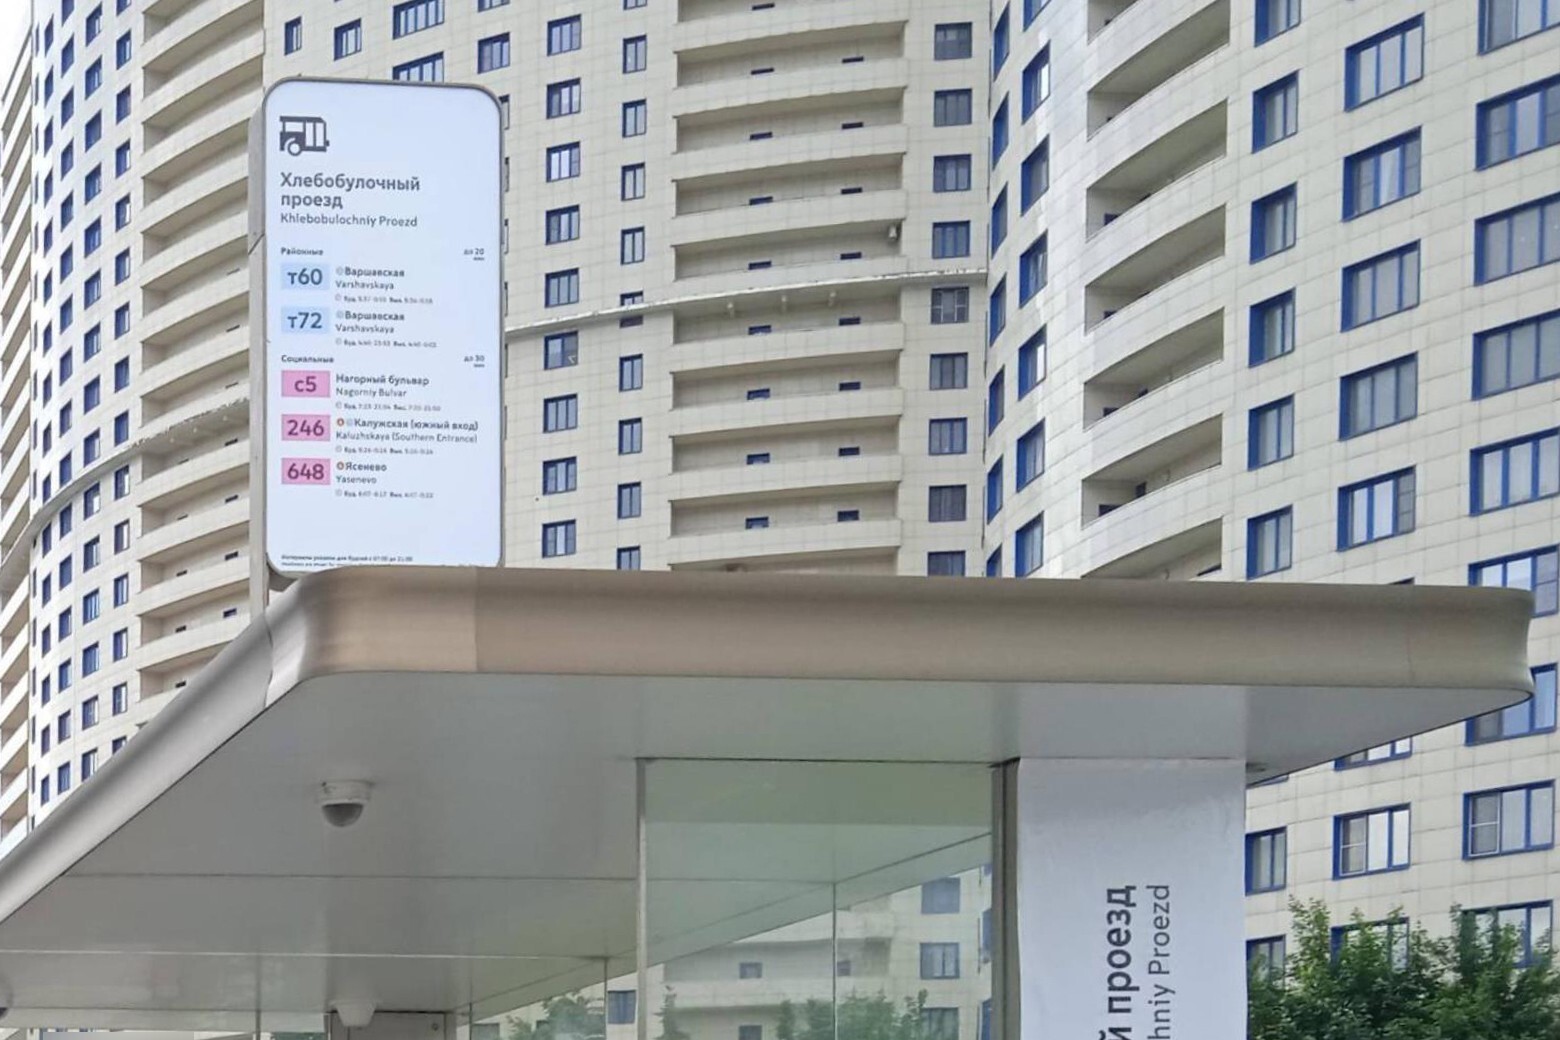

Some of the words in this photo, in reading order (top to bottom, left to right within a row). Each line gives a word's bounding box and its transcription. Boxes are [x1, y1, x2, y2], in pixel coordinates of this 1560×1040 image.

[280, 172, 420, 192] Хлебобулочный
[281, 194, 343, 209] проезд
[280, 213, 377, 228] Khlebobulochniy
[379, 216, 418, 227] Proezd
[287, 267, 323, 286] т60
[345, 267, 405, 279] Варшавская
[335, 280, 394, 290] Varshavskaya
[287, 312, 323, 329] т72
[345, 311, 405, 323] Варшавская
[335, 324, 395, 334] Varshavskaya
[336, 374, 386, 385] Нагорный
[388, 374, 429, 386] бульвар
[336, 388, 377, 398] Nagorniy
[379, 389, 407, 397] Bulvar
[288, 420, 324, 437] 246
[354, 418, 408, 430] Калужская
[411, 418, 449, 430] (южный
[452, 420, 478, 431] вход)
[336, 432, 390, 442] Kaluzhskaya
[392, 432, 435, 442] (Southern
[436, 433, 478, 444] Entrance)
[287, 463, 324, 480] 648
[345, 461, 387, 471] Ясенево
[336, 475, 377, 484] Yasenevo
[1146, 884, 1172, 975] Proezd
[1106, 885, 1140, 1014] проезд
